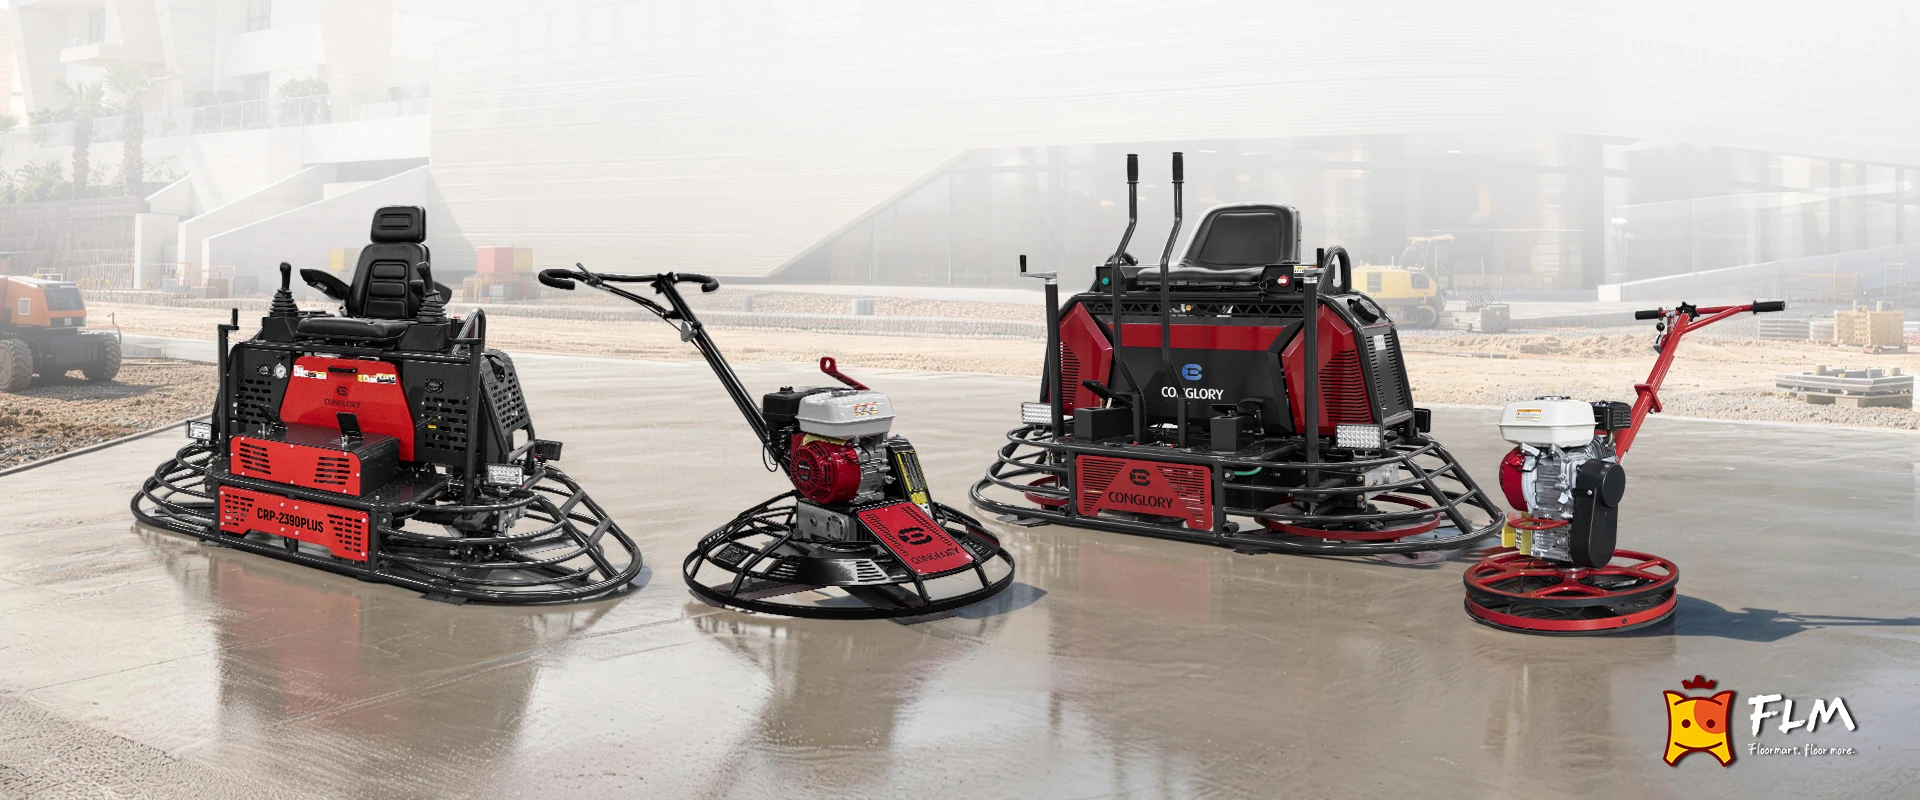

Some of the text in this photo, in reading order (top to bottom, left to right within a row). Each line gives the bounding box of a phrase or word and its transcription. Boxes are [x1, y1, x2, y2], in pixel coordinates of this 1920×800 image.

[1161, 386, 1224, 400] COGLORY
[324, 398, 362, 409] CONGLORY
[1108, 491, 1173, 509] CONGLORY
[257, 507, 324, 533] CRP-2390PLUS
[910, 546, 960, 565] CONGLORY
